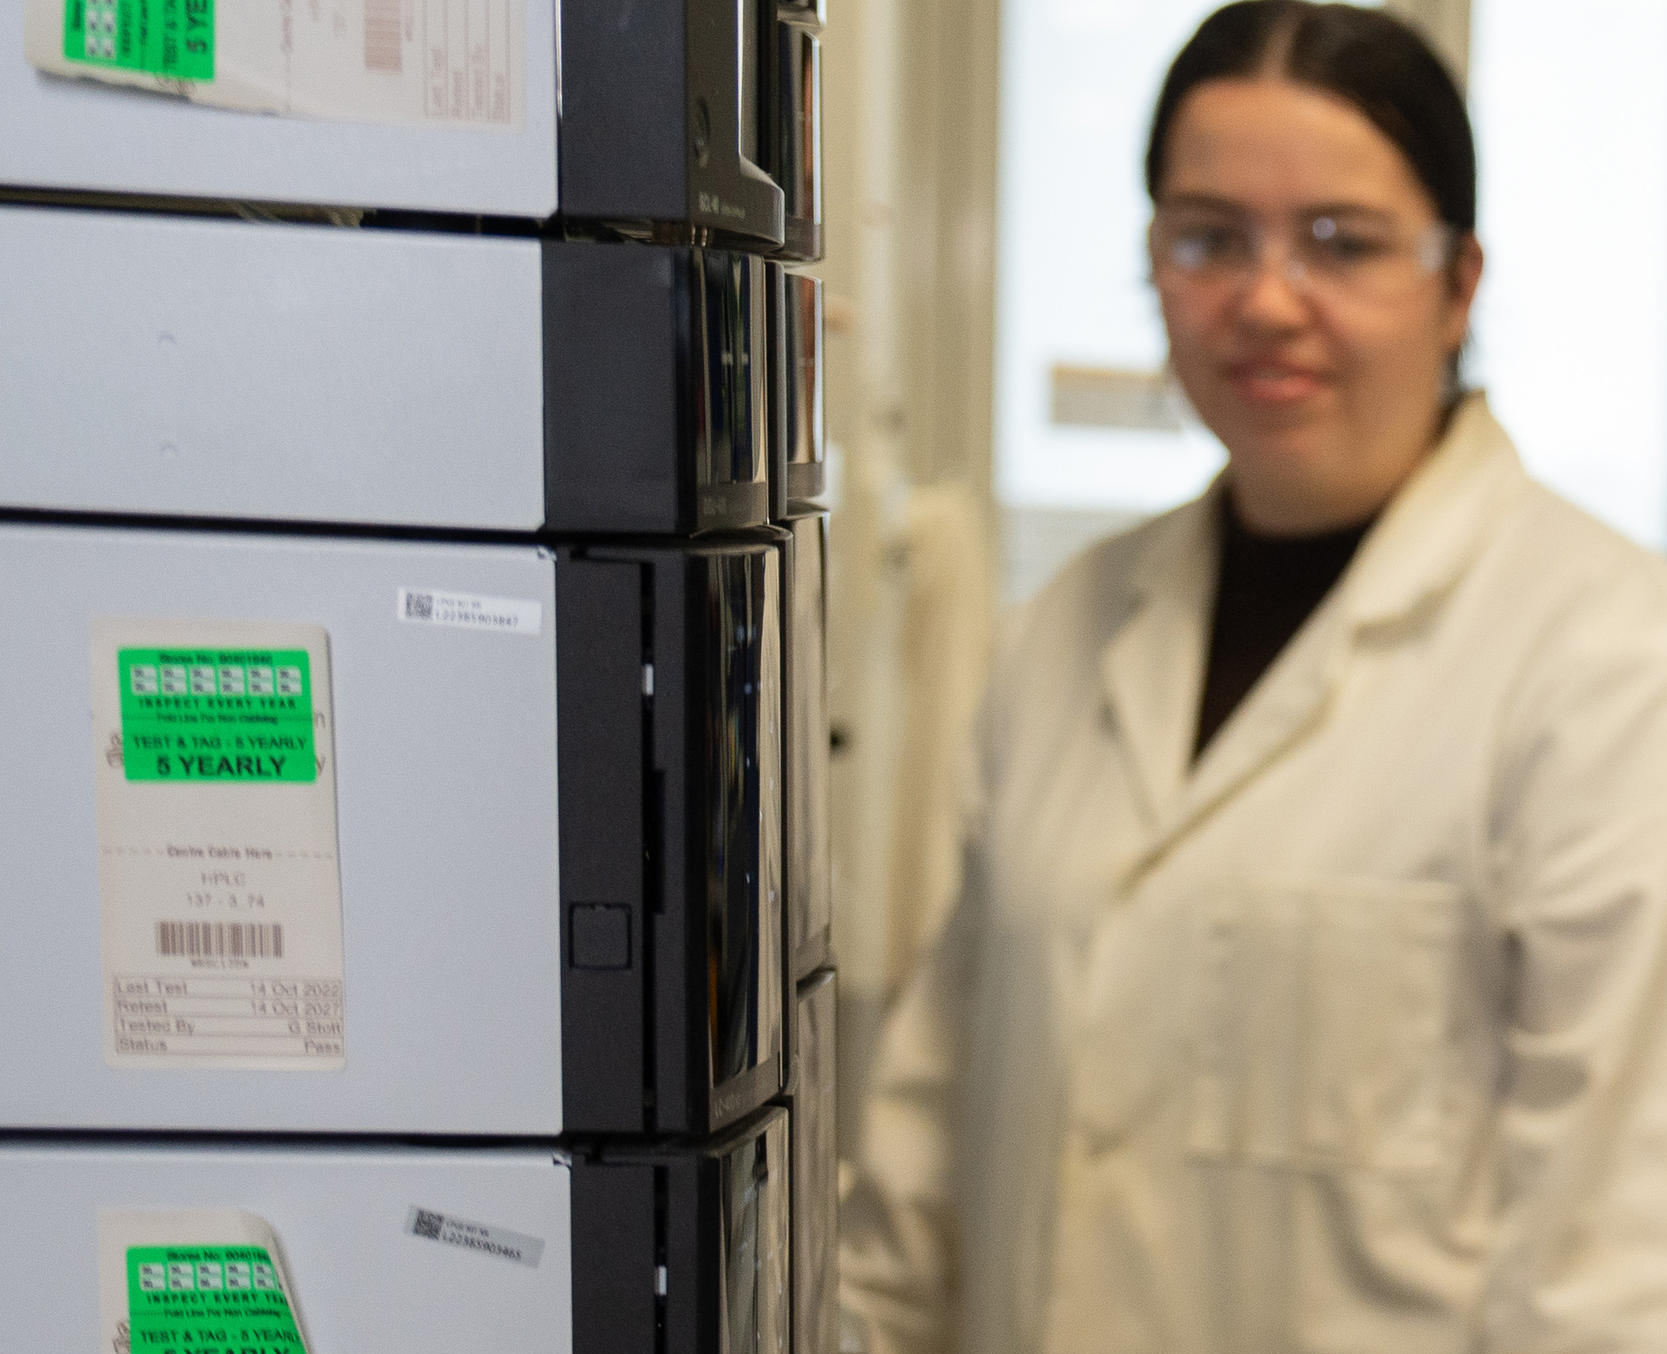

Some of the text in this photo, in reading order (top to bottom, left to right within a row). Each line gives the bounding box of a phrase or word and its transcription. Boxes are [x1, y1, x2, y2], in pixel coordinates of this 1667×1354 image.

[133, 736, 171, 750] TEST
[176, 737, 187, 749] &
[191, 737, 221, 750] TAG
[247, 736, 307, 750] YEARLY
[156, 754, 287, 777] 5 YEARLY
[116, 980, 152, 995] Last
[156, 980, 188, 995] Test
[250, 982, 267, 996] 14
[271, 983, 299, 996] Oct
[117, 1000, 168, 1014] Retest
[250, 1001, 267, 1014] 14
[272, 1002, 299, 1015] Oct
[118, 1018, 171, 1033] Tested
[175, 1018, 195, 1036] By
[118, 1038, 341, 1054] Status Pass
[140, 1329, 179, 1344] TEST
[183, 1330, 194, 1343] &
[199, 1330, 228, 1343] TAG
